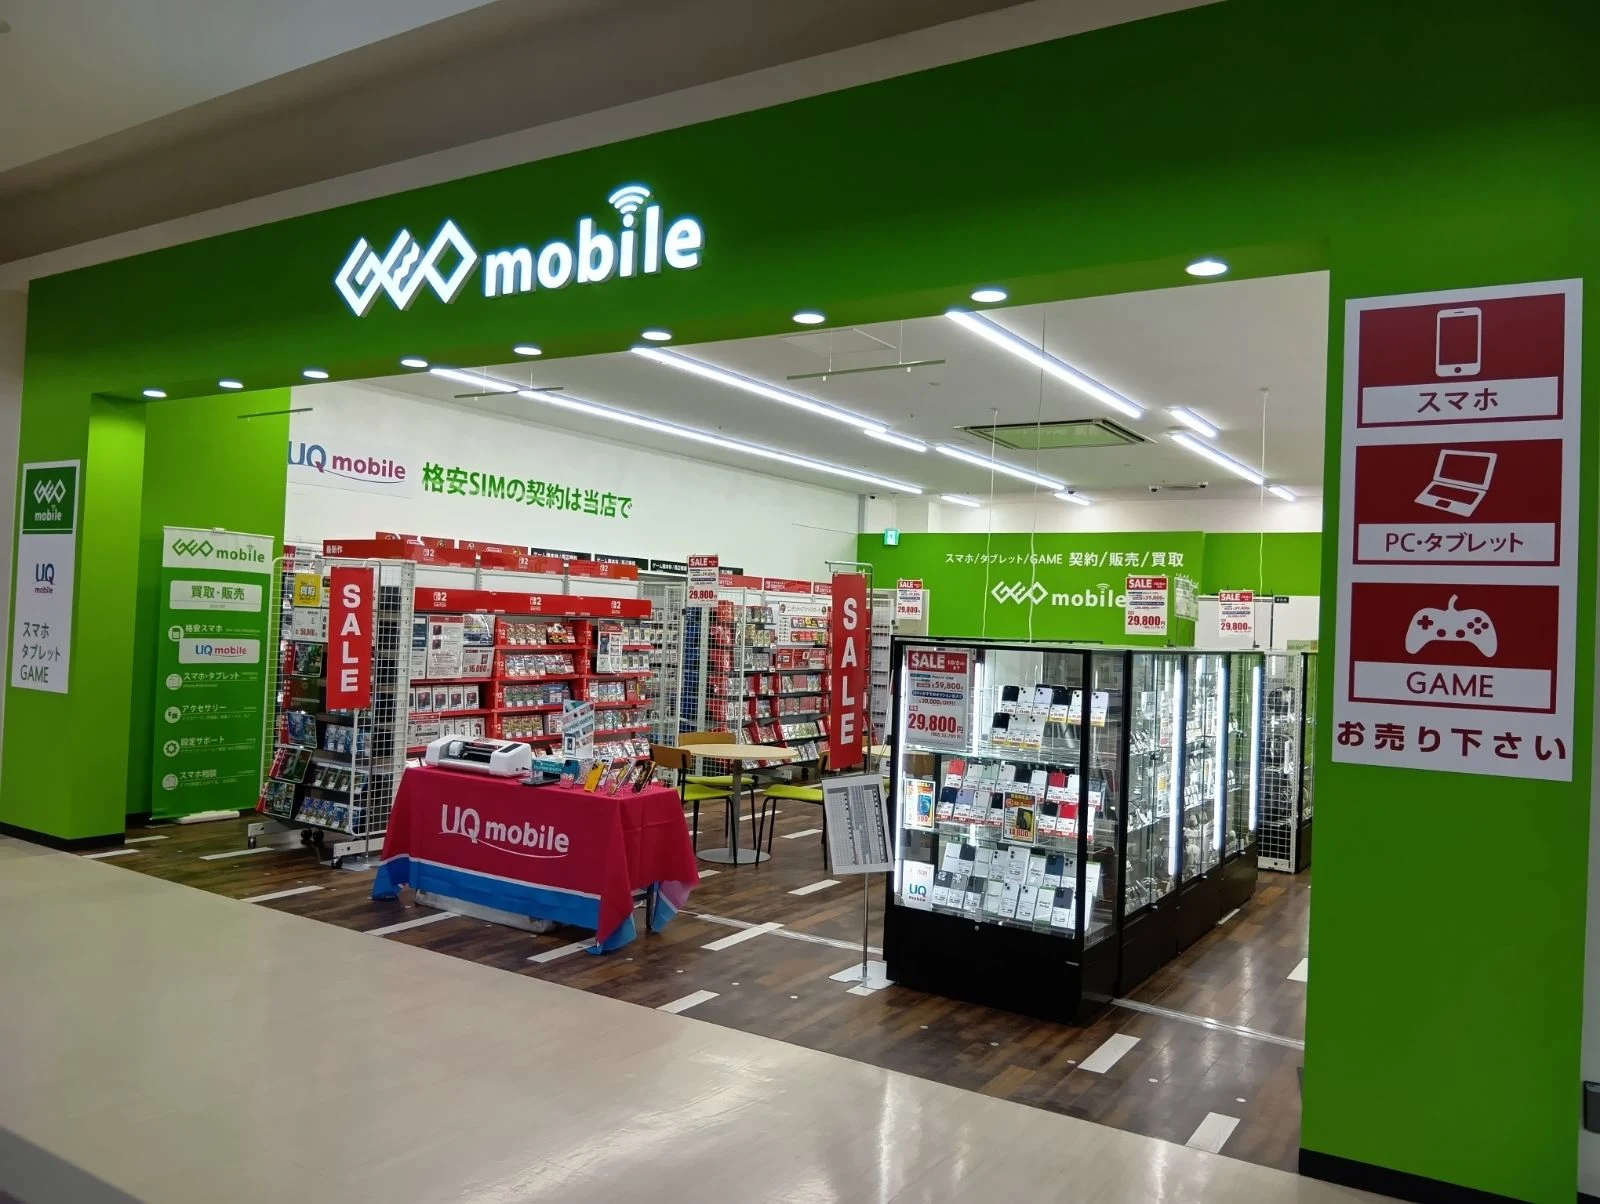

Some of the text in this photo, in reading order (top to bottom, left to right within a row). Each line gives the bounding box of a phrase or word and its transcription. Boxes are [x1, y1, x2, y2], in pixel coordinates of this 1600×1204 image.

[334, 204, 702, 317] GEO mobile
[1416, 387, 1499, 414] スマホ
[288, 441, 406, 480] UQ mobile
[33, 479, 67, 504] GEO
[422, 461, 633, 519] 格安SIMの契約は当店で
[34, 509, 62, 521] mobile
[172, 538, 214, 557] GEO
[216, 548, 265, 563] mobile
[1384, 532, 1524, 554] PC・タブレット
[690, 558, 708, 567] SALE
[944, 551, 1184, 567] スマホ/タブレット/GAME 契約/販売/買取
[35, 563, 55, 585] UQ
[191, 585, 245, 601] 買取・販売
[991, 580, 1126, 607] GEO mobile
[1128, 579, 1153, 589] SALE
[1221, 593, 1241, 601] SALE
[22, 622, 49, 639] スマホ
[185, 623, 223, 633] 格安スマホ
[340, 583, 361, 692] SALE
[21, 643, 61, 662] タブレット
[195, 644, 247, 656] UQ mobile
[911, 652, 945, 669] SALE
[20, 664, 49, 684] GAME
[183, 671, 240, 680] スマホ・タブレット
[840, 597, 858, 745] SALE
[1405, 671, 1494, 699] GAME
[182, 703, 228, 713] アクセサリー
[180, 736, 225, 747] 設定サポート
[1336, 720, 1567, 762] お売り下さい
[441, 804, 570, 853] UQ mobile
[909, 884, 927, 897] UQ
